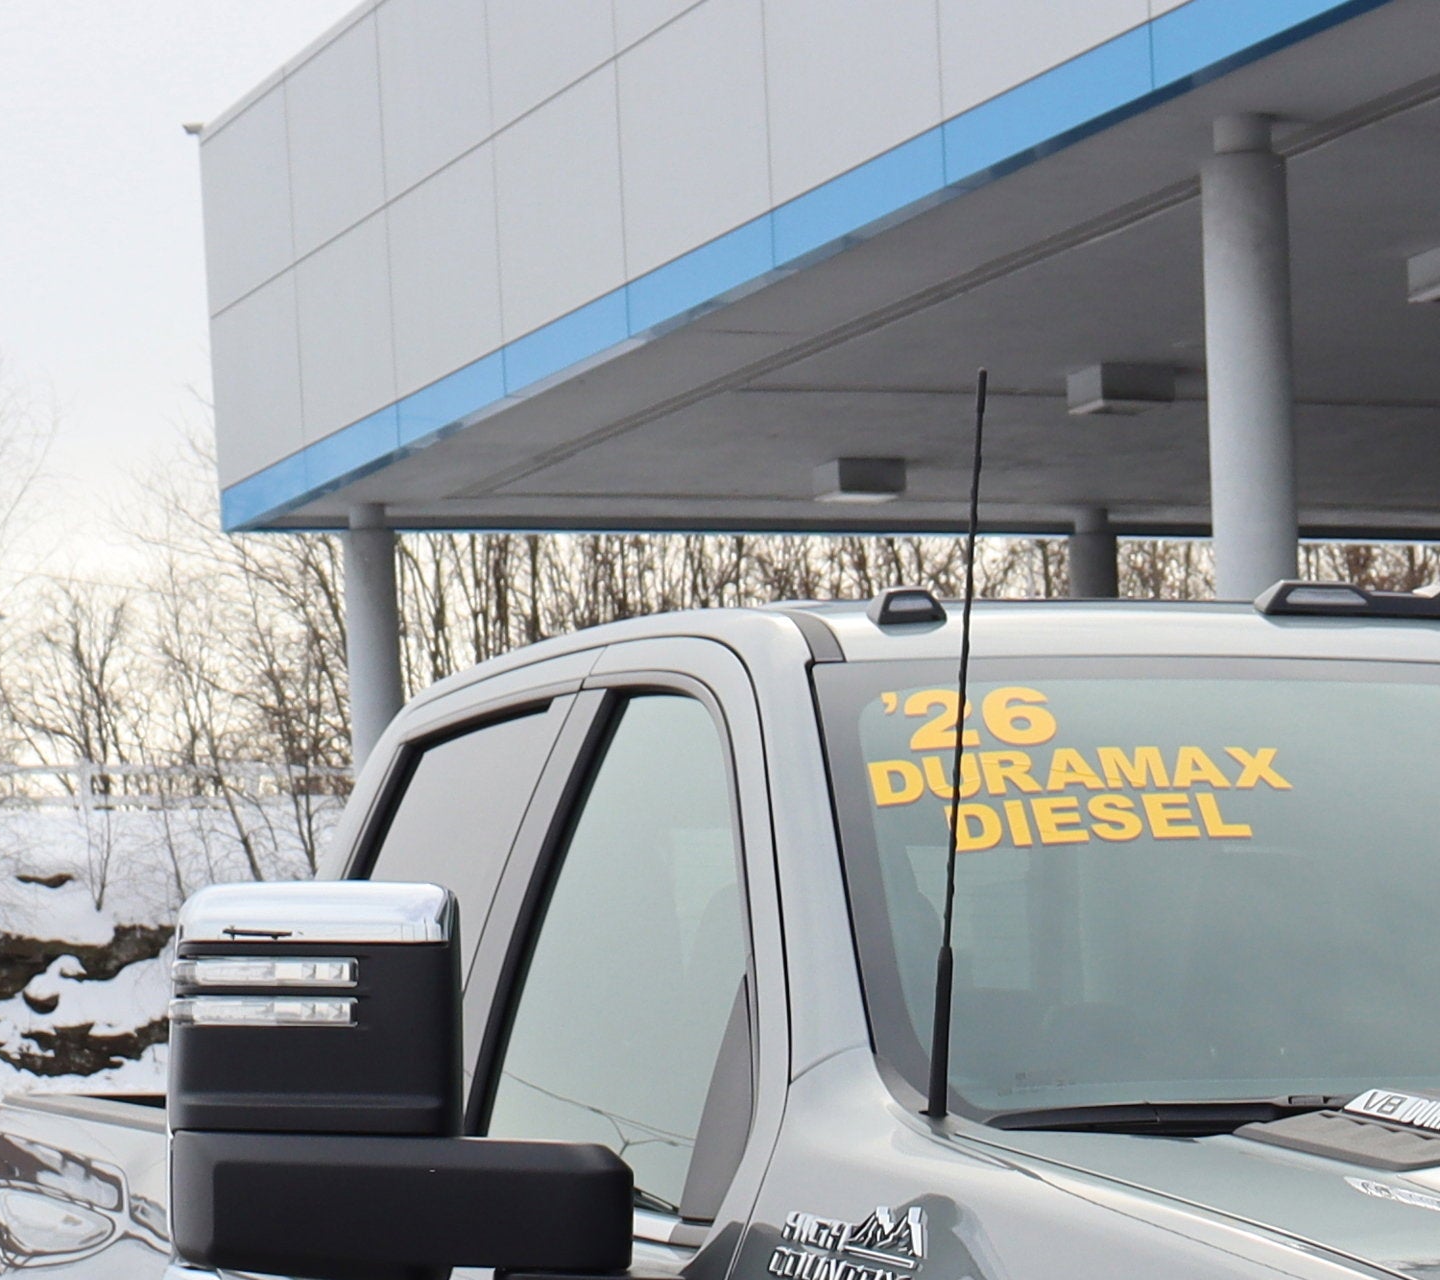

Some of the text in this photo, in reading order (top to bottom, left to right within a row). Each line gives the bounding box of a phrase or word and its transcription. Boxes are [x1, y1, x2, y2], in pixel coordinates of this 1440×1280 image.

[866, 746, 1294, 807] DURAMAX
[944, 793, 1253, 852] DIESEL
[1362, 1091, 1403, 1114] V8
[781, 1210, 853, 1252] HIGH
